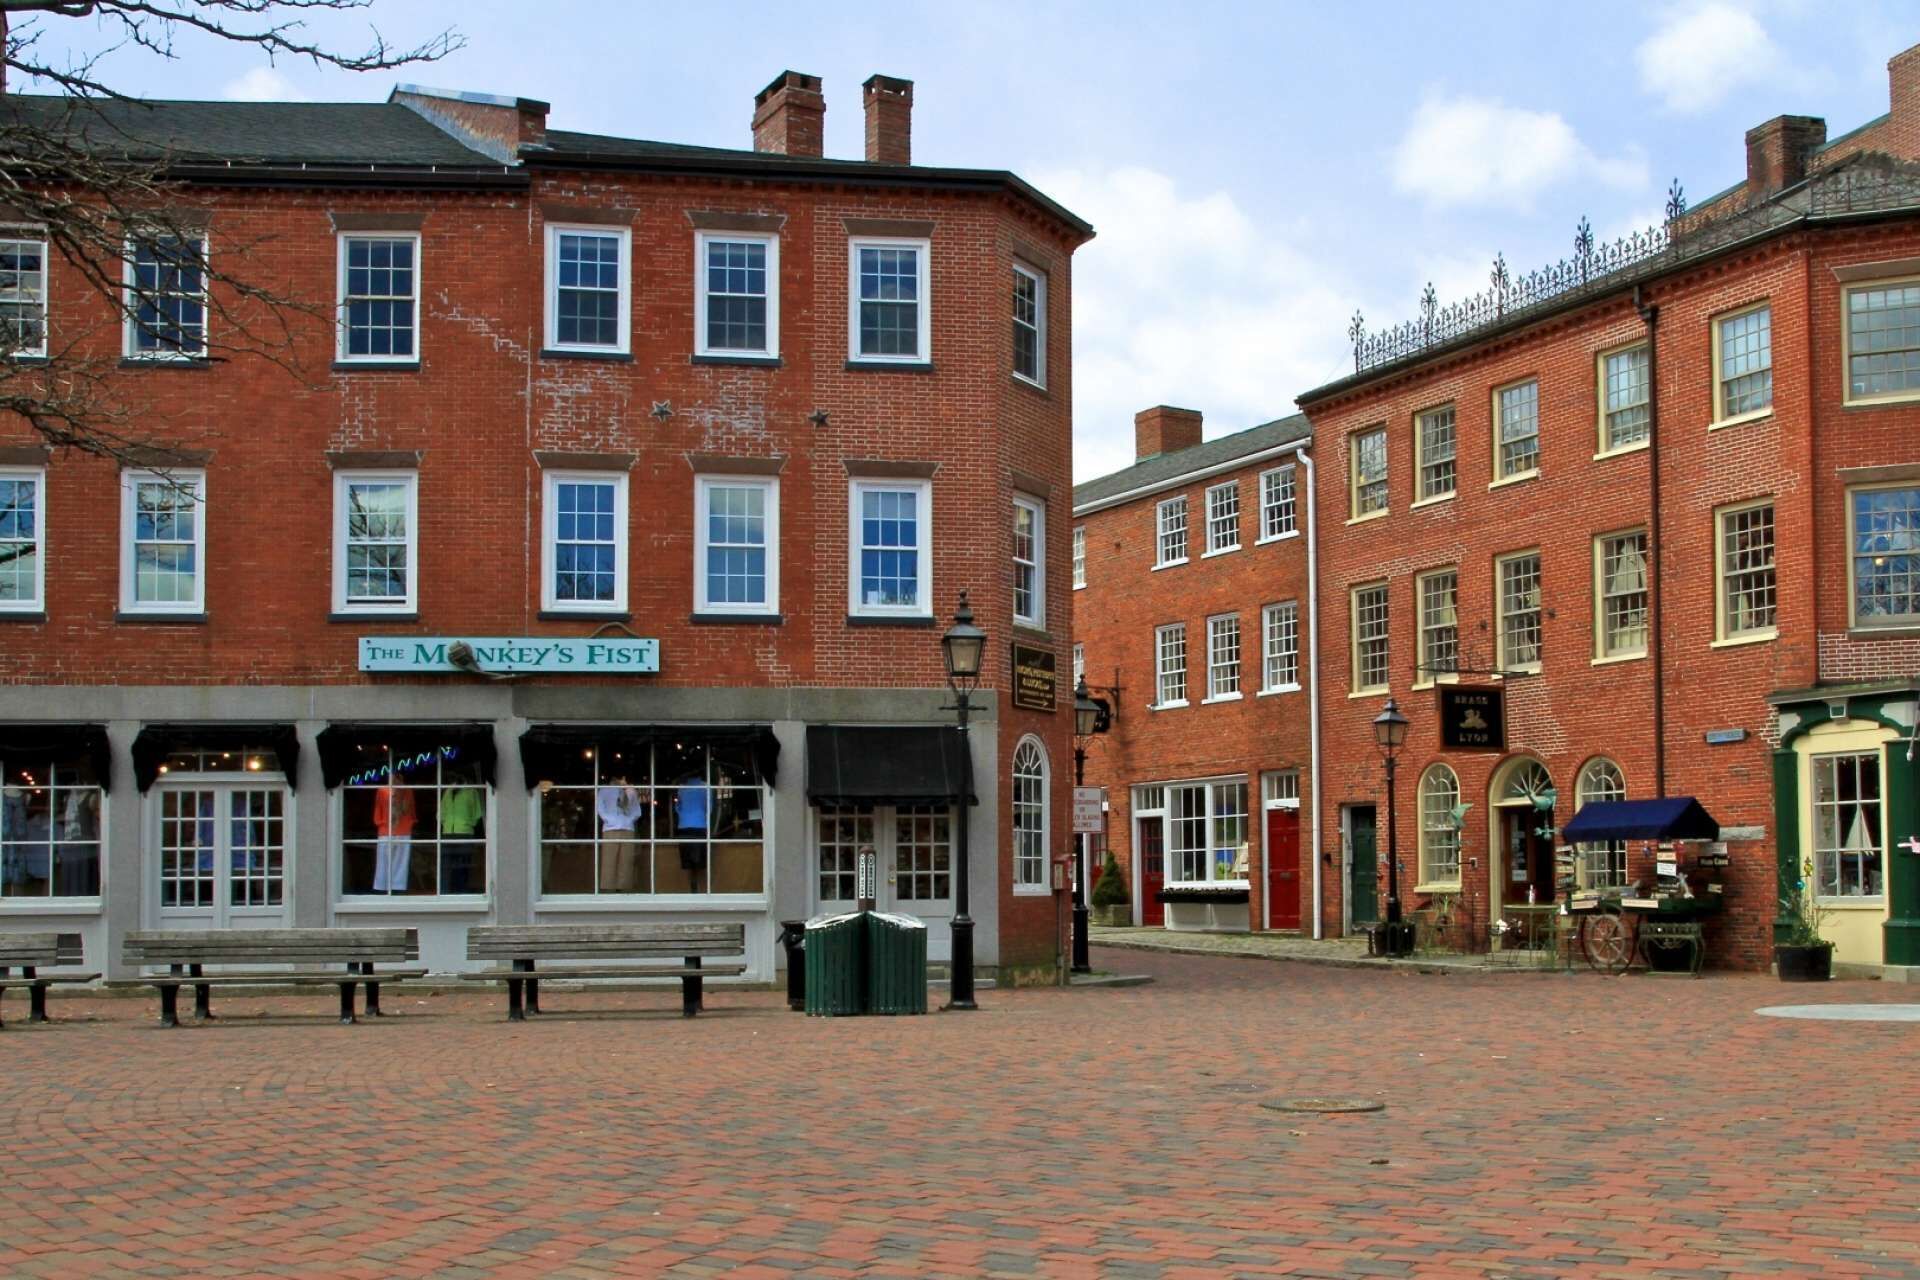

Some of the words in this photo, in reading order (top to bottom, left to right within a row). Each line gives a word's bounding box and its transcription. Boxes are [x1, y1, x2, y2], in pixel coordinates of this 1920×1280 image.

[366, 646, 405, 661] THE
[412, 643, 575, 666] MNKEY'S
[586, 644, 651, 665] FIST
